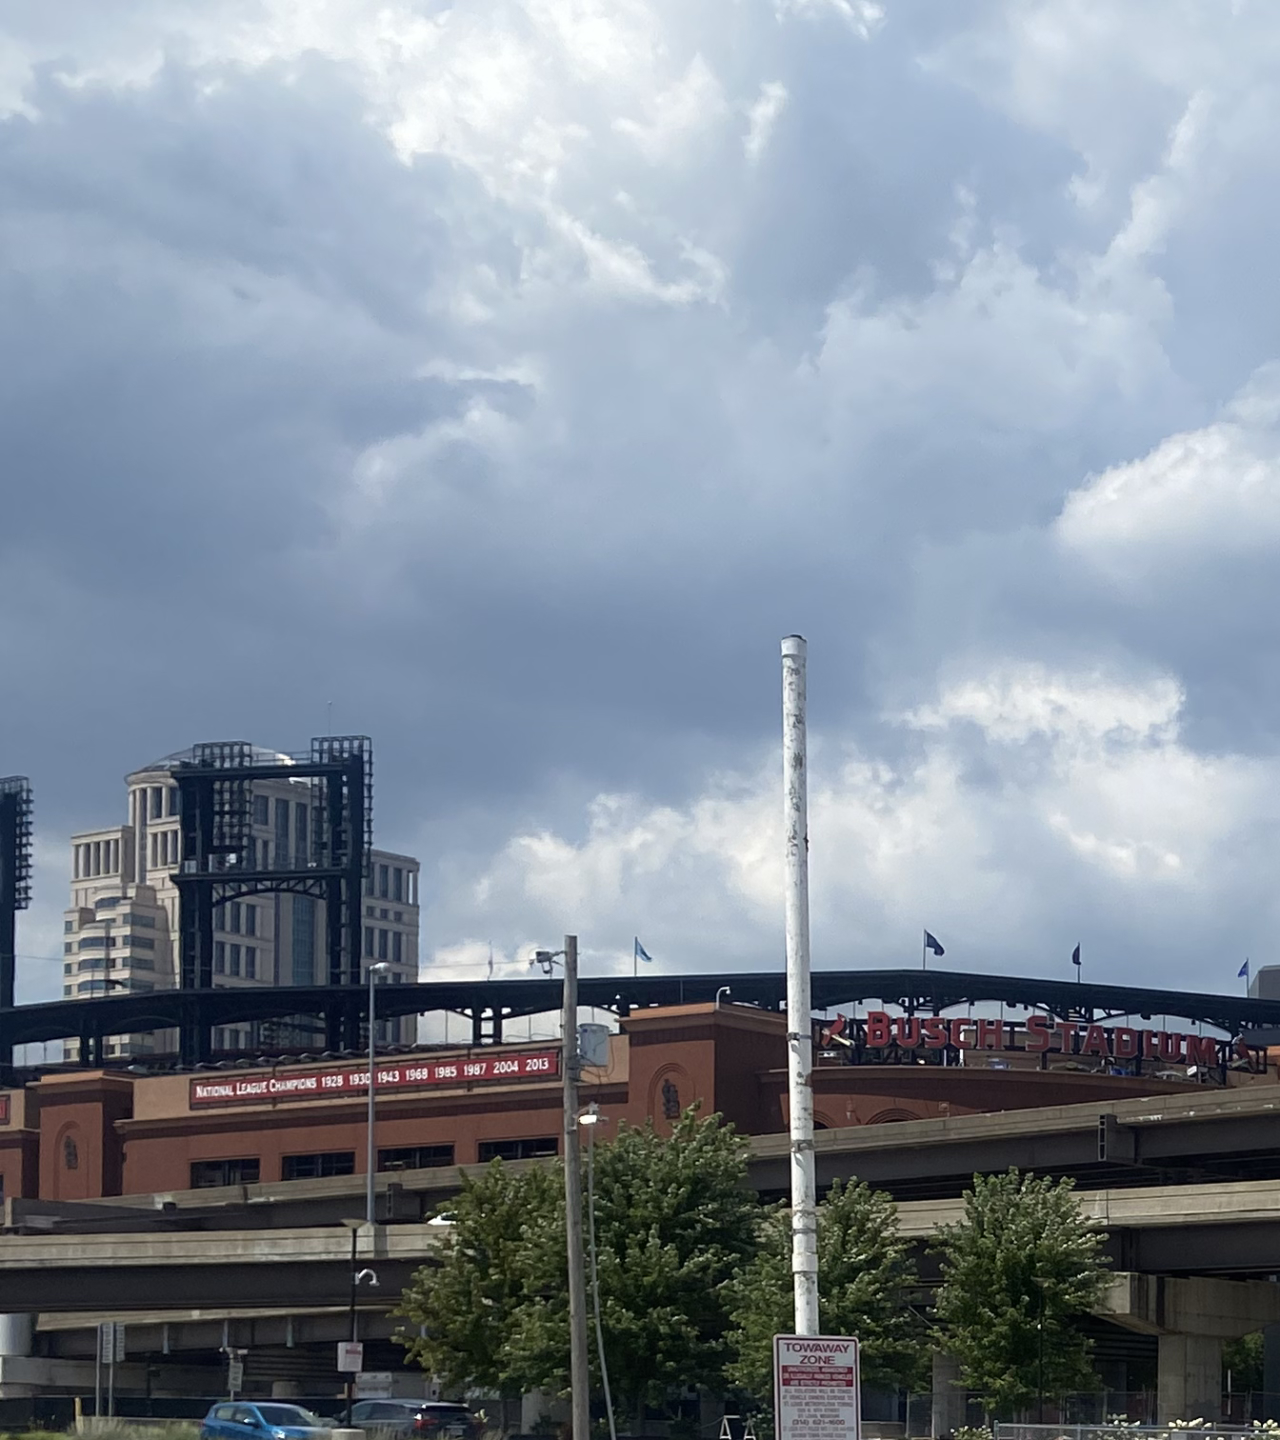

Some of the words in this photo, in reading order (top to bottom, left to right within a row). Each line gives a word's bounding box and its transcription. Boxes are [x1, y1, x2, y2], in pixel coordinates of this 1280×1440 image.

[865, 1010, 1005, 1050] BUSCH
[1024, 1014, 1217, 1065] STADIUM
[195, 1085, 234, 1098] NATIONAL
[236, 1081, 268, 1095] LEAGUE
[268, 1076, 317, 1092] CHAMPIONS
[321, 1075, 343, 1088] 1928
[349, 1072, 371, 1086] 1930
[377, 1070, 400, 1084] 1943
[405, 1068, 428, 1081] 1968
[434, 1065, 457, 1078] 1985
[463, 1063, 487, 1076] 1987
[493, 1060, 519, 1074] 2004
[525, 1058, 549, 1071] 2013
[784, 1342, 850, 1353] TOWAWAY
[799, 1355, 836, 1365] ZONE
